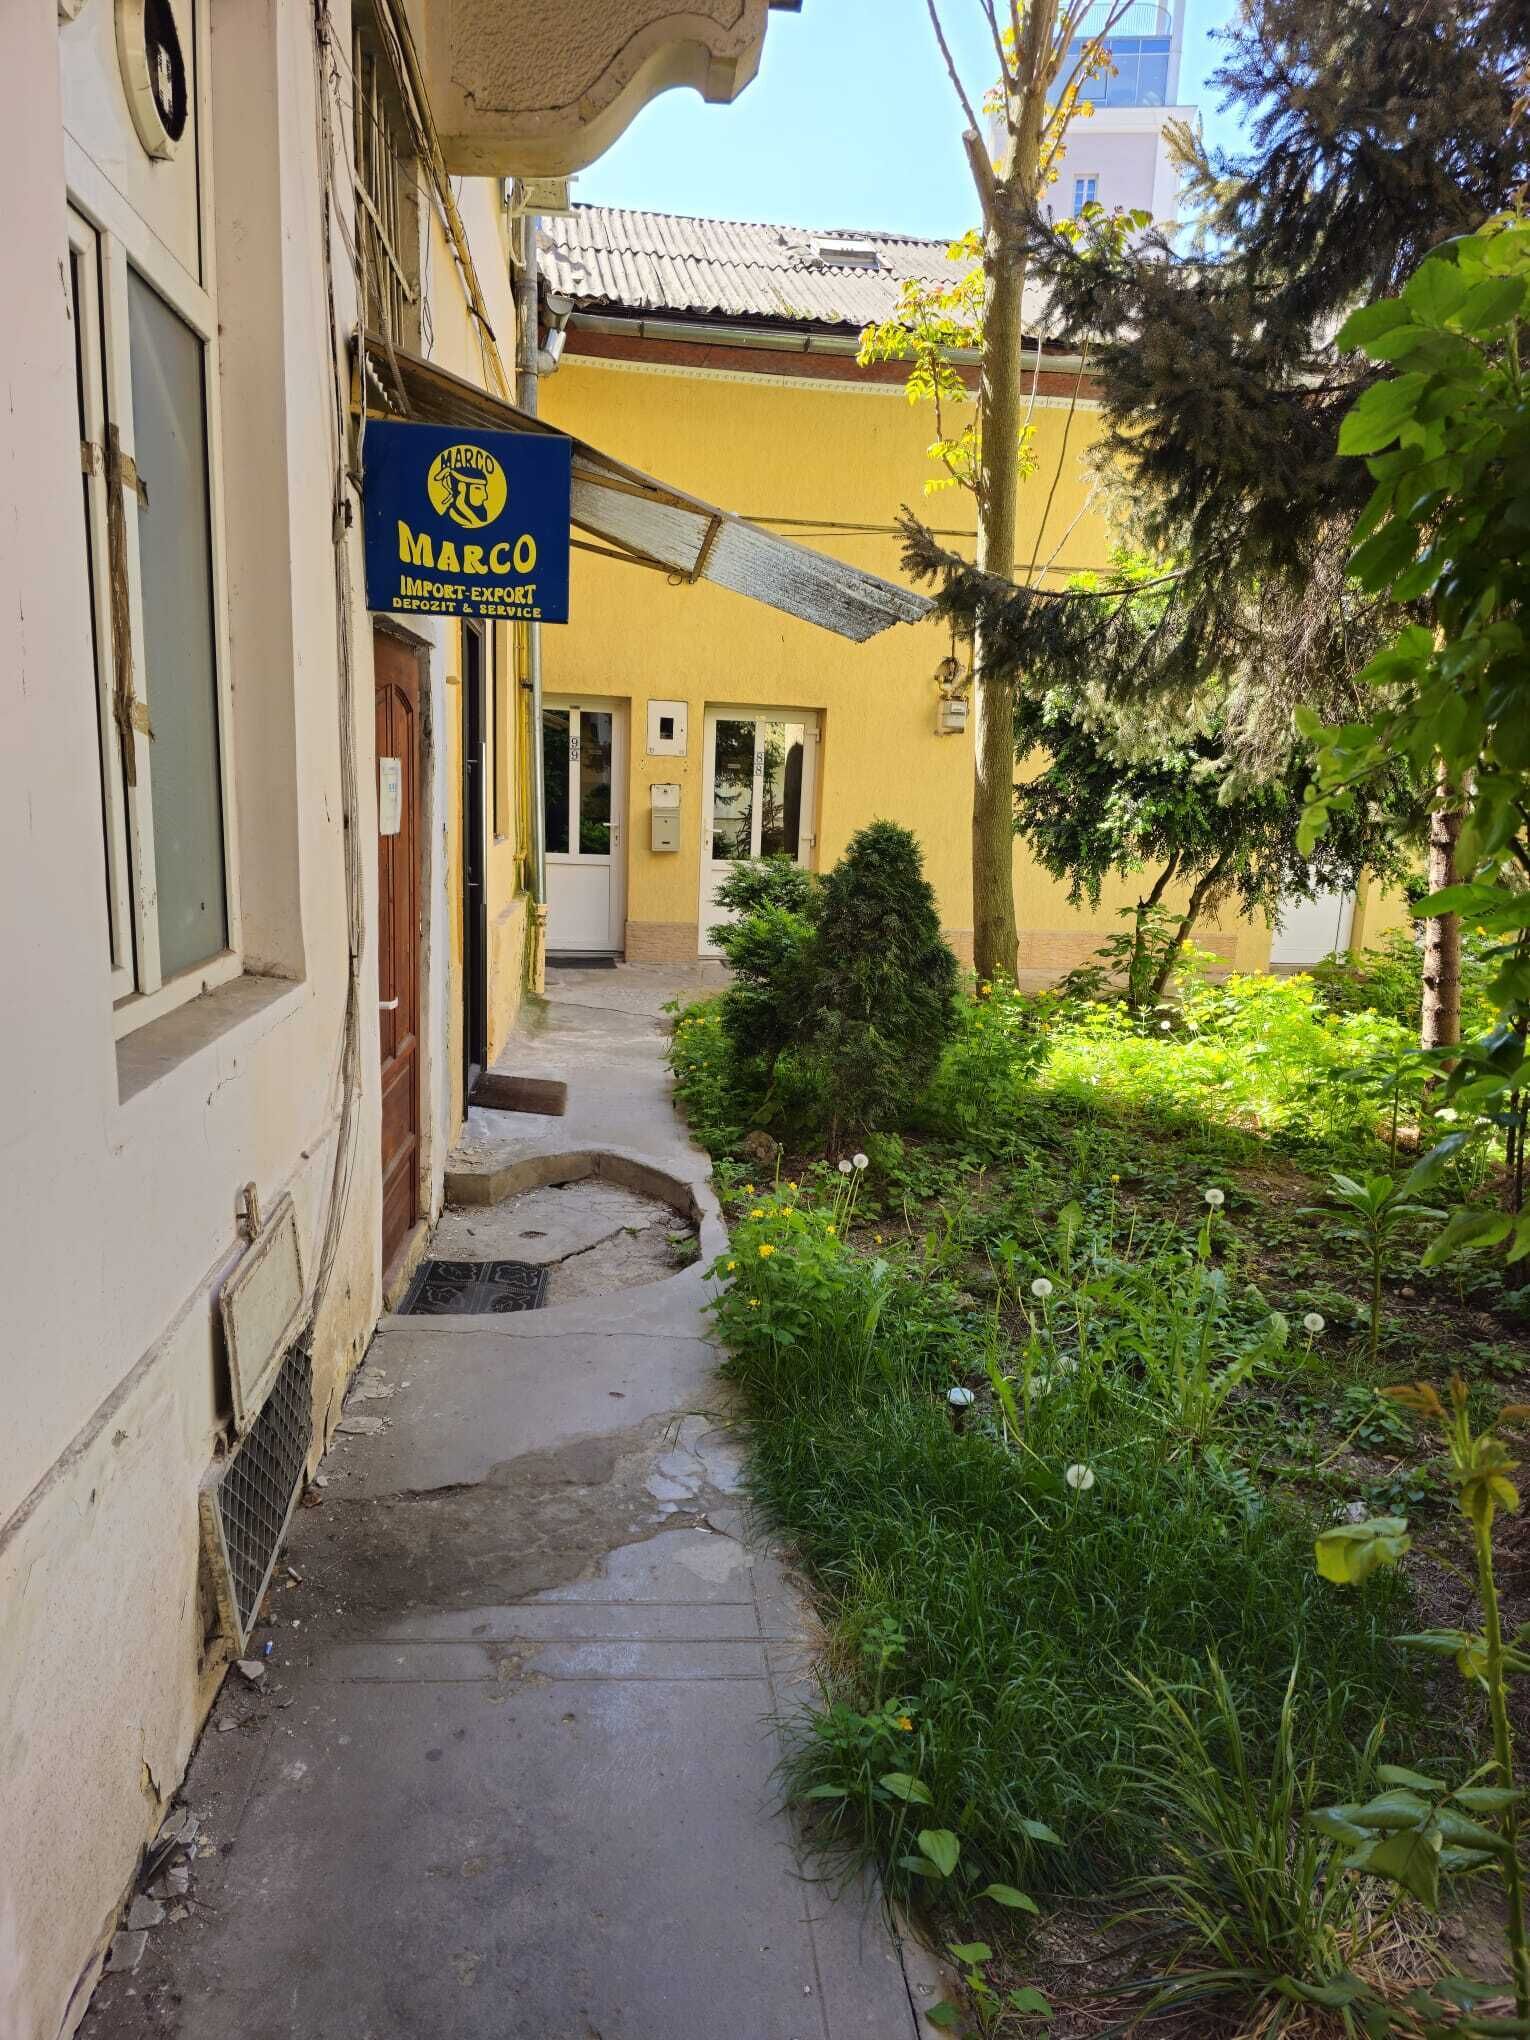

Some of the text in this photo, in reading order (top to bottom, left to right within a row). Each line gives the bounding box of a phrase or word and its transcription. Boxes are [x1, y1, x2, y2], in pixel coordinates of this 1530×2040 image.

[440, 447, 495, 475] MARCO
[397, 519, 537, 575] MARCO
[400, 574, 537, 605] IMPORT-EXPORT
[392, 597, 542, 619] DEPOZIT & SERVICE
